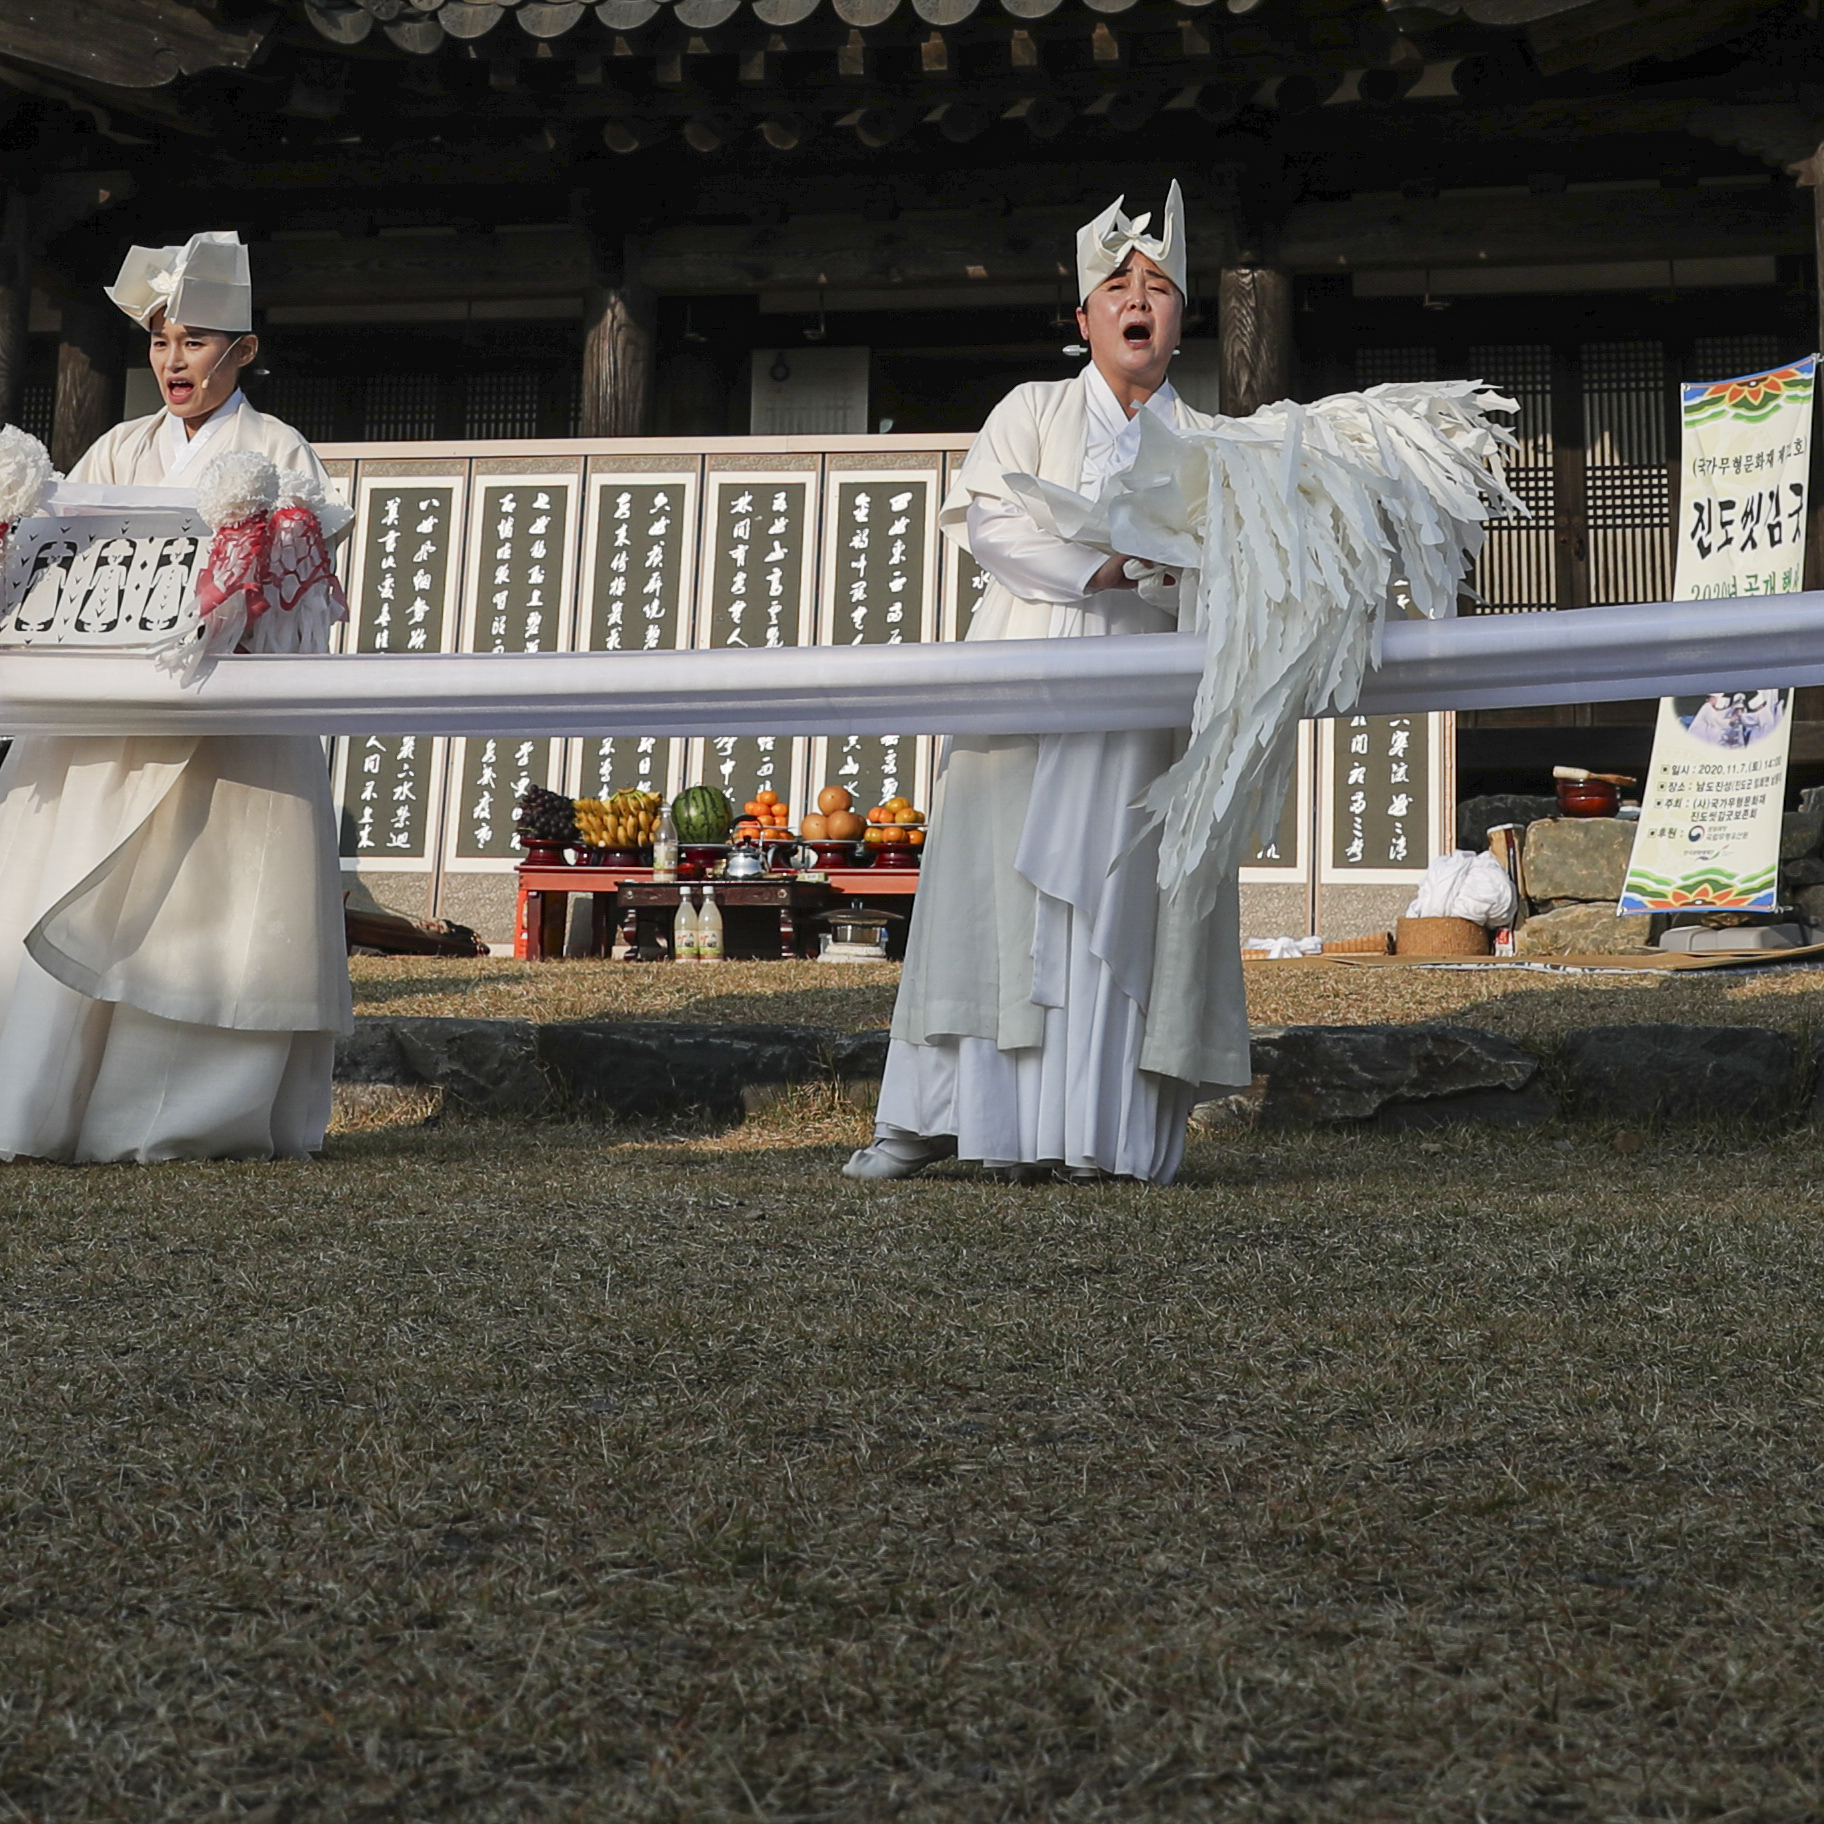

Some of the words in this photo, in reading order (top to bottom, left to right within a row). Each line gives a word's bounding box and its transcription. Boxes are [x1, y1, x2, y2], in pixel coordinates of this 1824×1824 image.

[1691, 483, 1803, 559] 진도씻김굿
[1671, 765, 1690, 775] 일시
[1668, 782, 1685, 792] 장소
[1658, 828, 1677, 839] 후원
